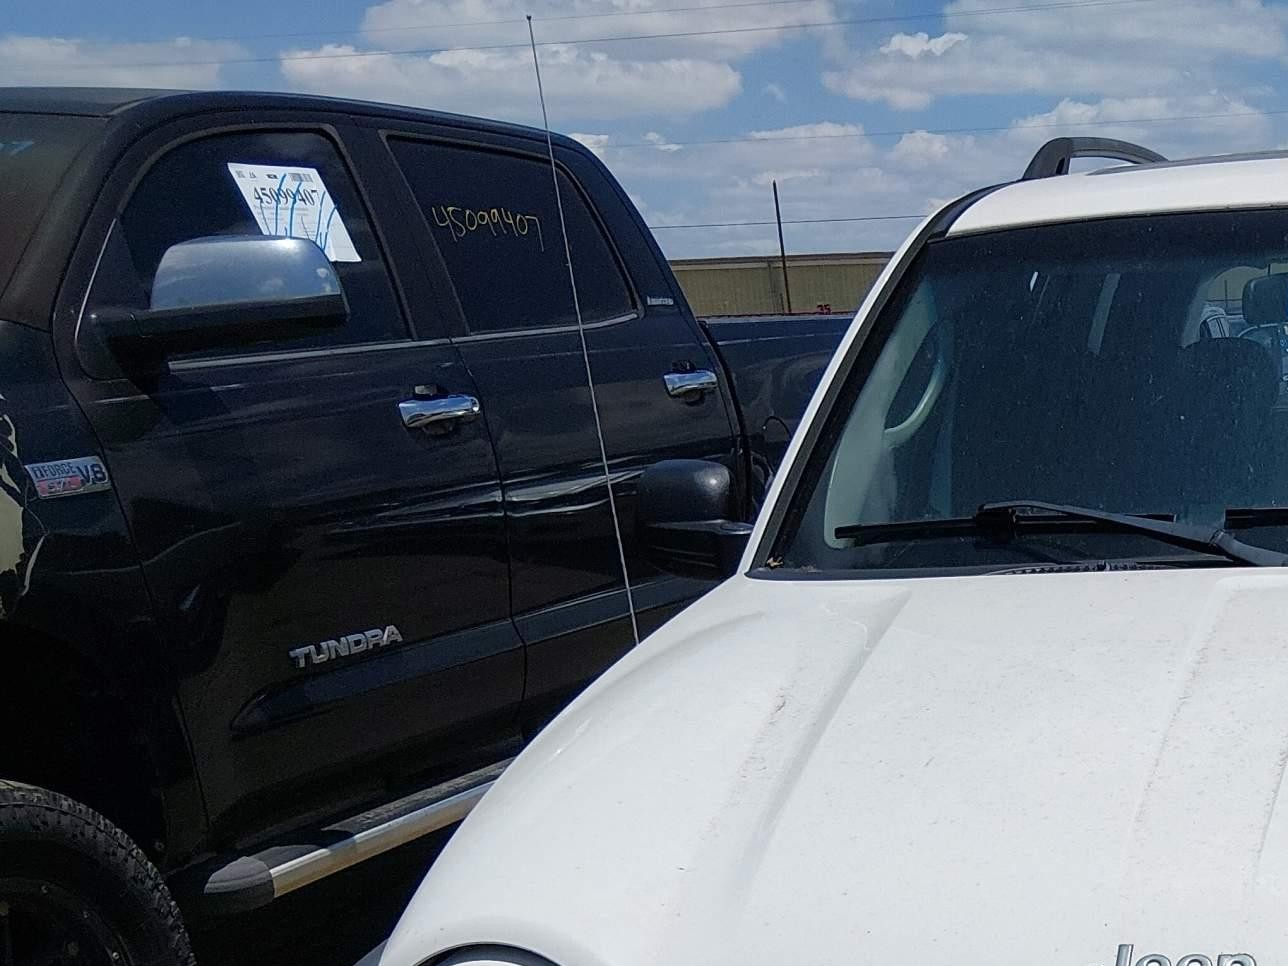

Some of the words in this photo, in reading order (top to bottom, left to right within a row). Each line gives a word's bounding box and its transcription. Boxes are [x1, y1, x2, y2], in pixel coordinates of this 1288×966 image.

[253, 186, 320, 206] 45099407
[431, 206, 544, 252] 45099407
[76, 463, 108, 484] V8
[289, 624, 403, 669] TUNDRA
